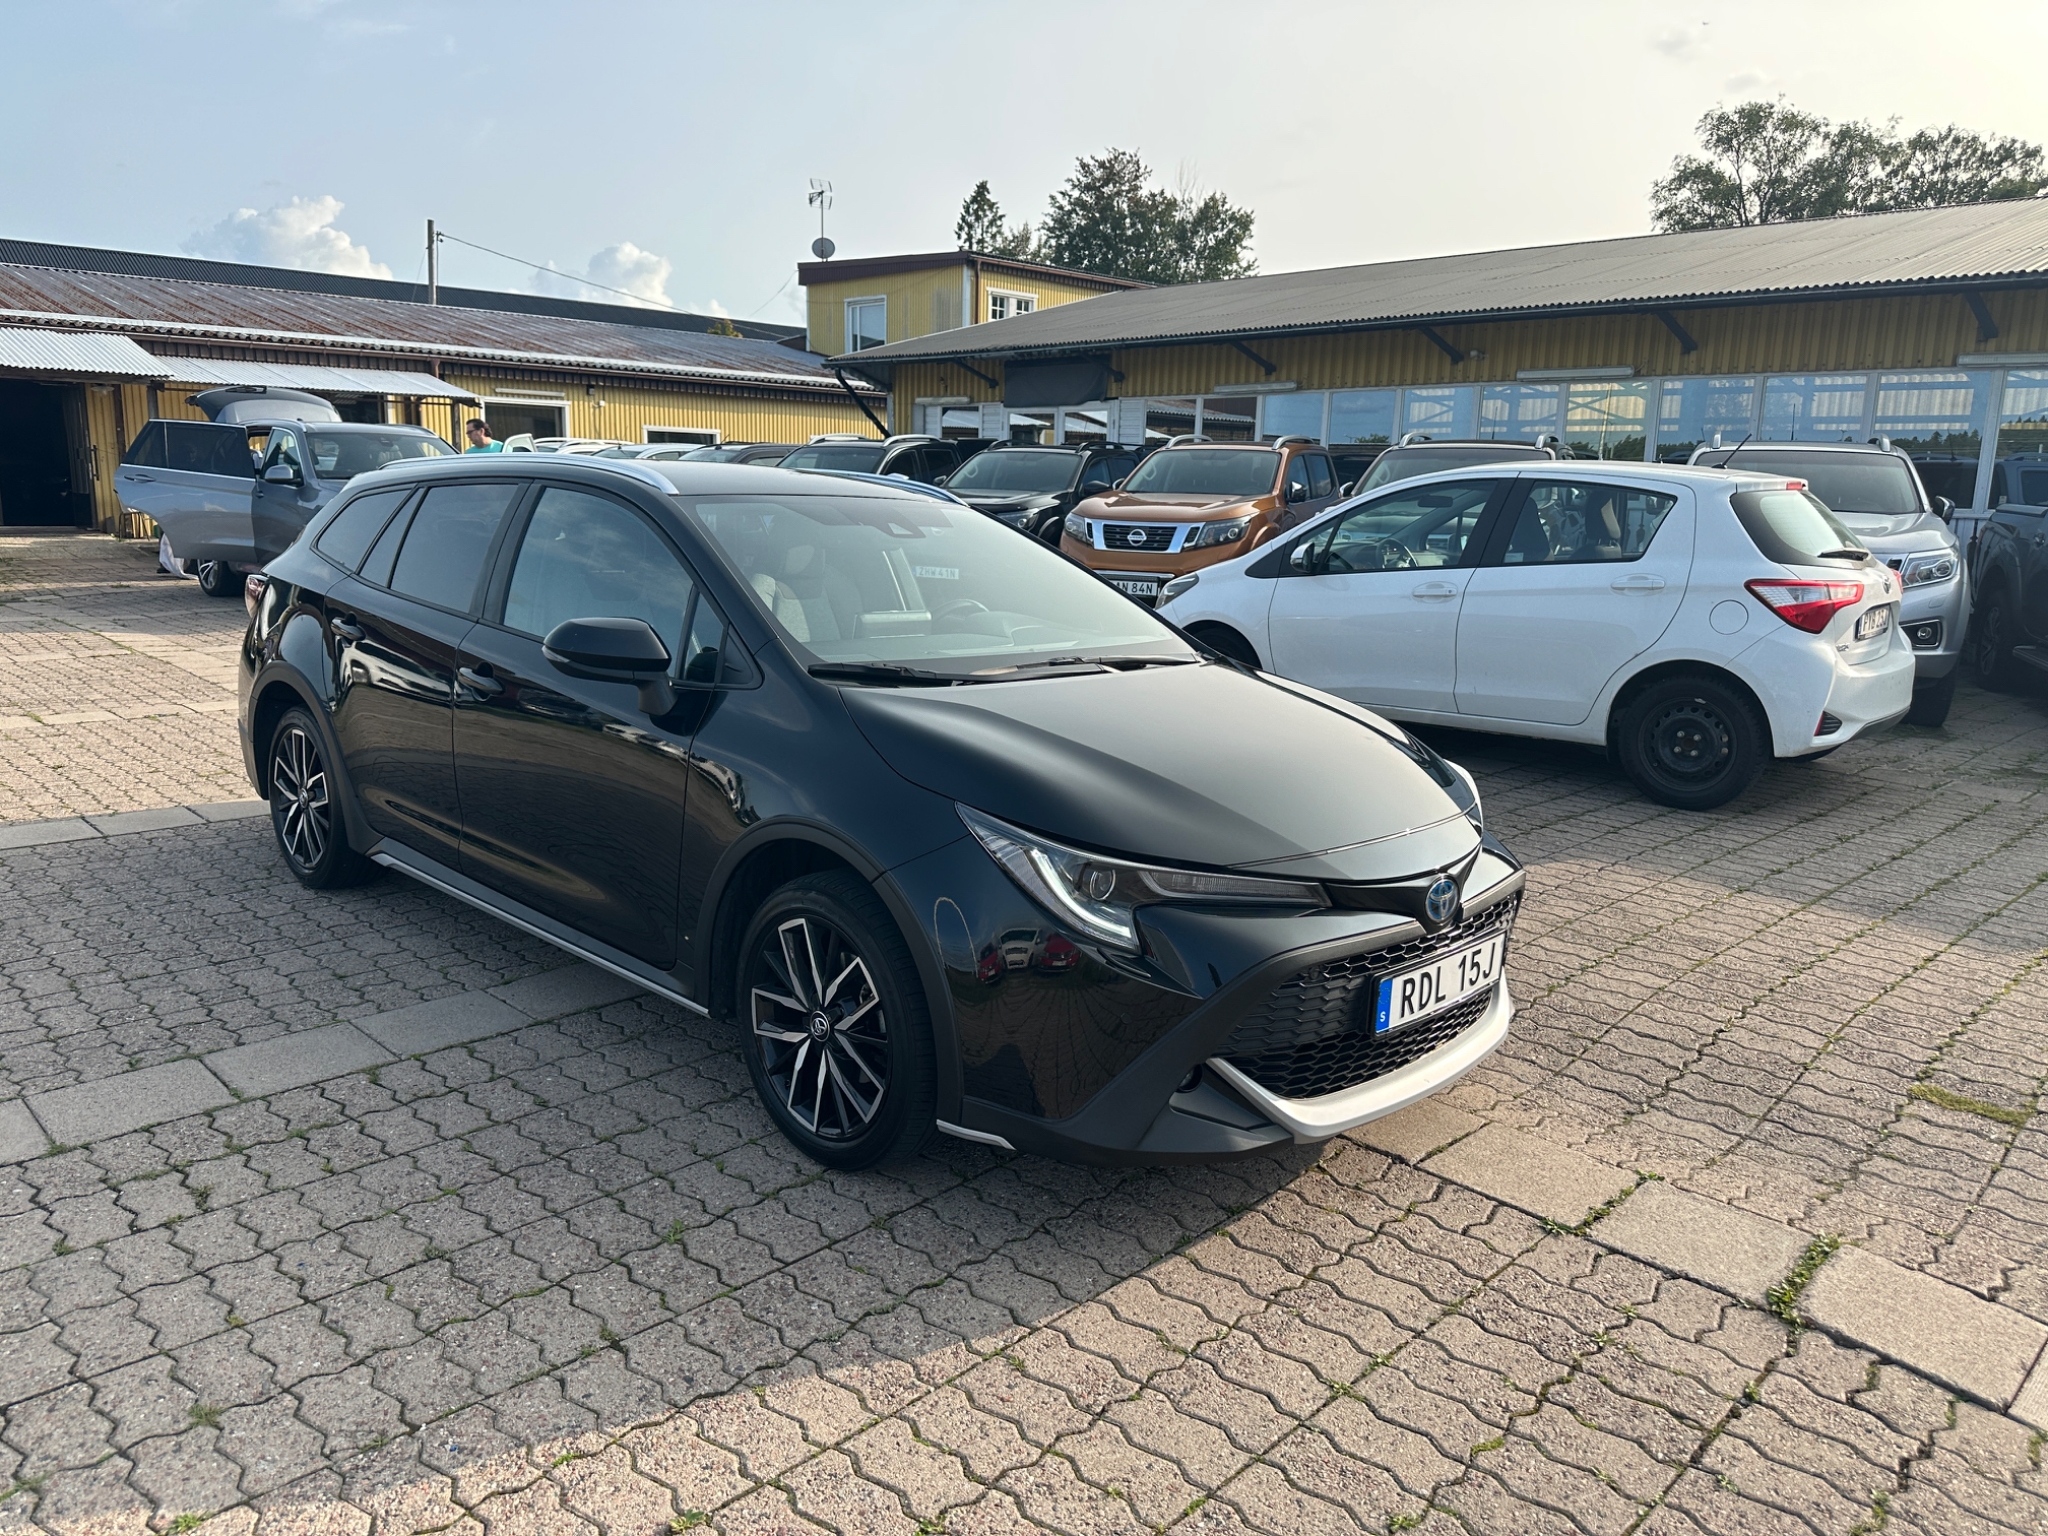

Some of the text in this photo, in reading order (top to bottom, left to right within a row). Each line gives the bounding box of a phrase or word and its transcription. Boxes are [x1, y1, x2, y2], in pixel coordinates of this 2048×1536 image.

[938, 568, 956, 578] 41N
[1131, 582, 1153, 594] 84N
[1400, 942, 1496, 1019] RDL 15J
[1379, 1011, 1387, 1022] S
